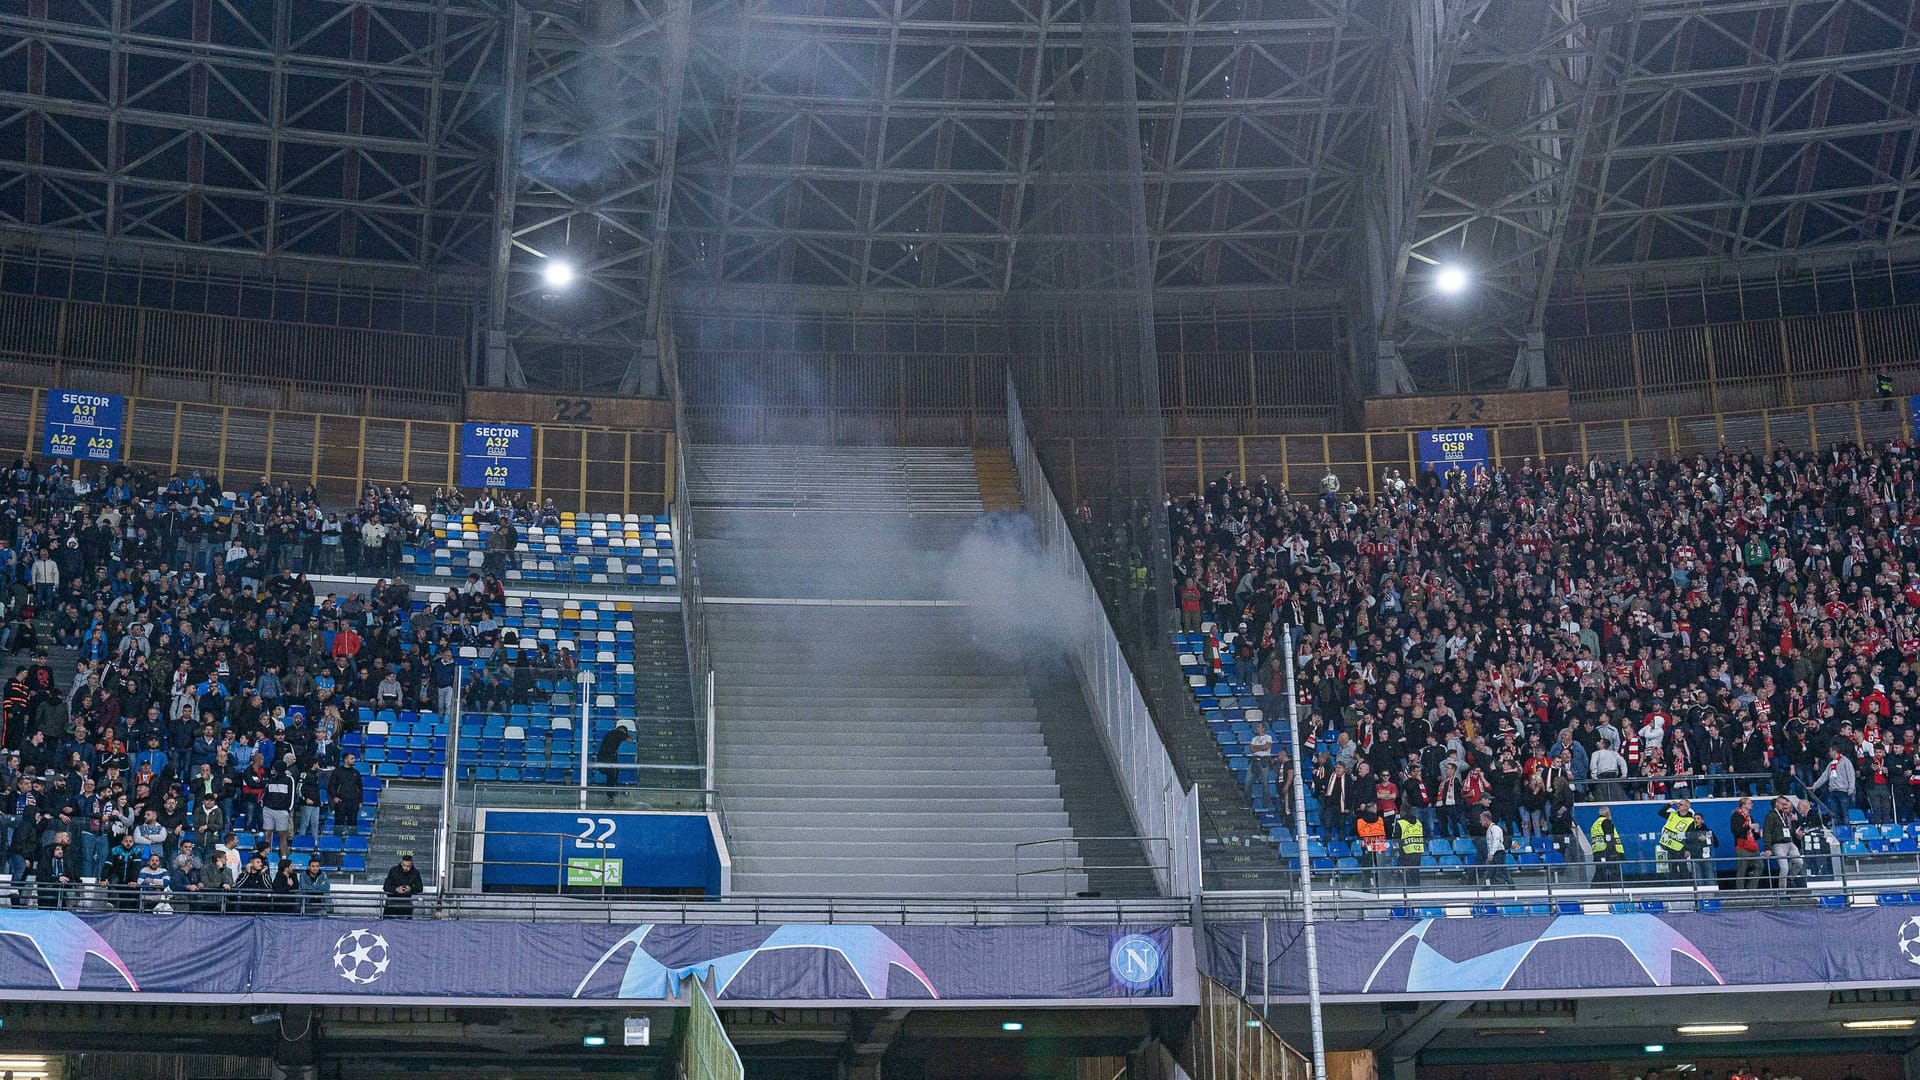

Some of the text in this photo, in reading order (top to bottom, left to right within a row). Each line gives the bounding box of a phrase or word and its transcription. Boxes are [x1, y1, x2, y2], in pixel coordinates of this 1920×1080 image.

[62, 394, 109, 407] SECTOR
[72, 404, 97, 416] A31
[554, 399, 592, 421] 22
[475, 427, 519, 438] SECTOR
[1431, 432, 1474, 443] SECTOR
[50, 433, 113, 449] A22 A23
[485, 437, 509, 448] A32
[484, 466, 508, 477] A23
[575, 817, 616, 849] 22
[1125, 948, 1151, 977] N
